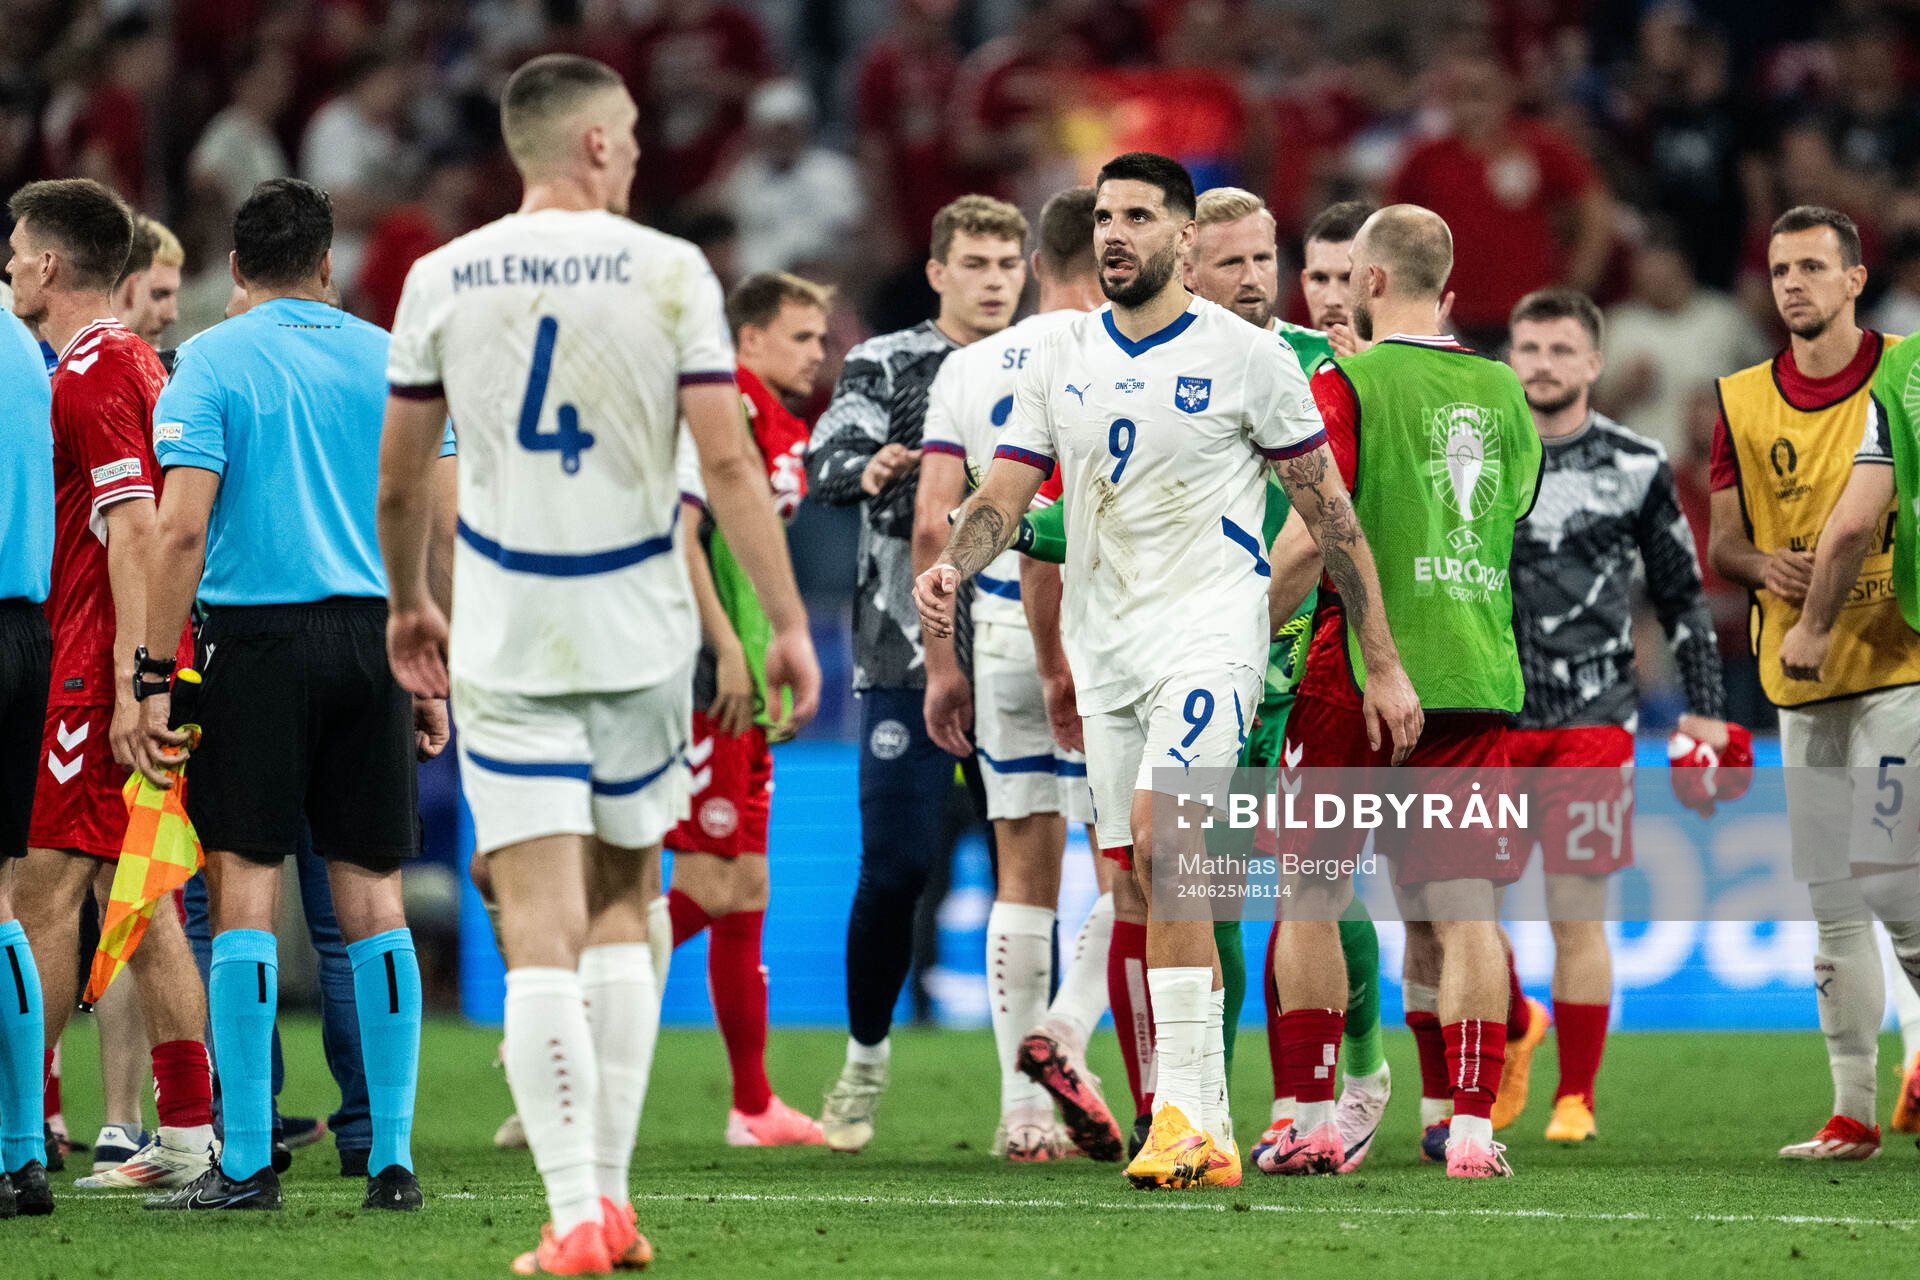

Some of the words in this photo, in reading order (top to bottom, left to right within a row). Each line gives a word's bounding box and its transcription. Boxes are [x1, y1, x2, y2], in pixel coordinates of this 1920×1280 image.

[452, 248, 633, 291] MILENKOVIĆ
[517, 315, 595, 475] 4
[1108, 418, 1136, 484] 9
[1181, 689, 1215, 748] 9
[1874, 755, 1906, 817] 5
[1566, 801, 1624, 860] 24
